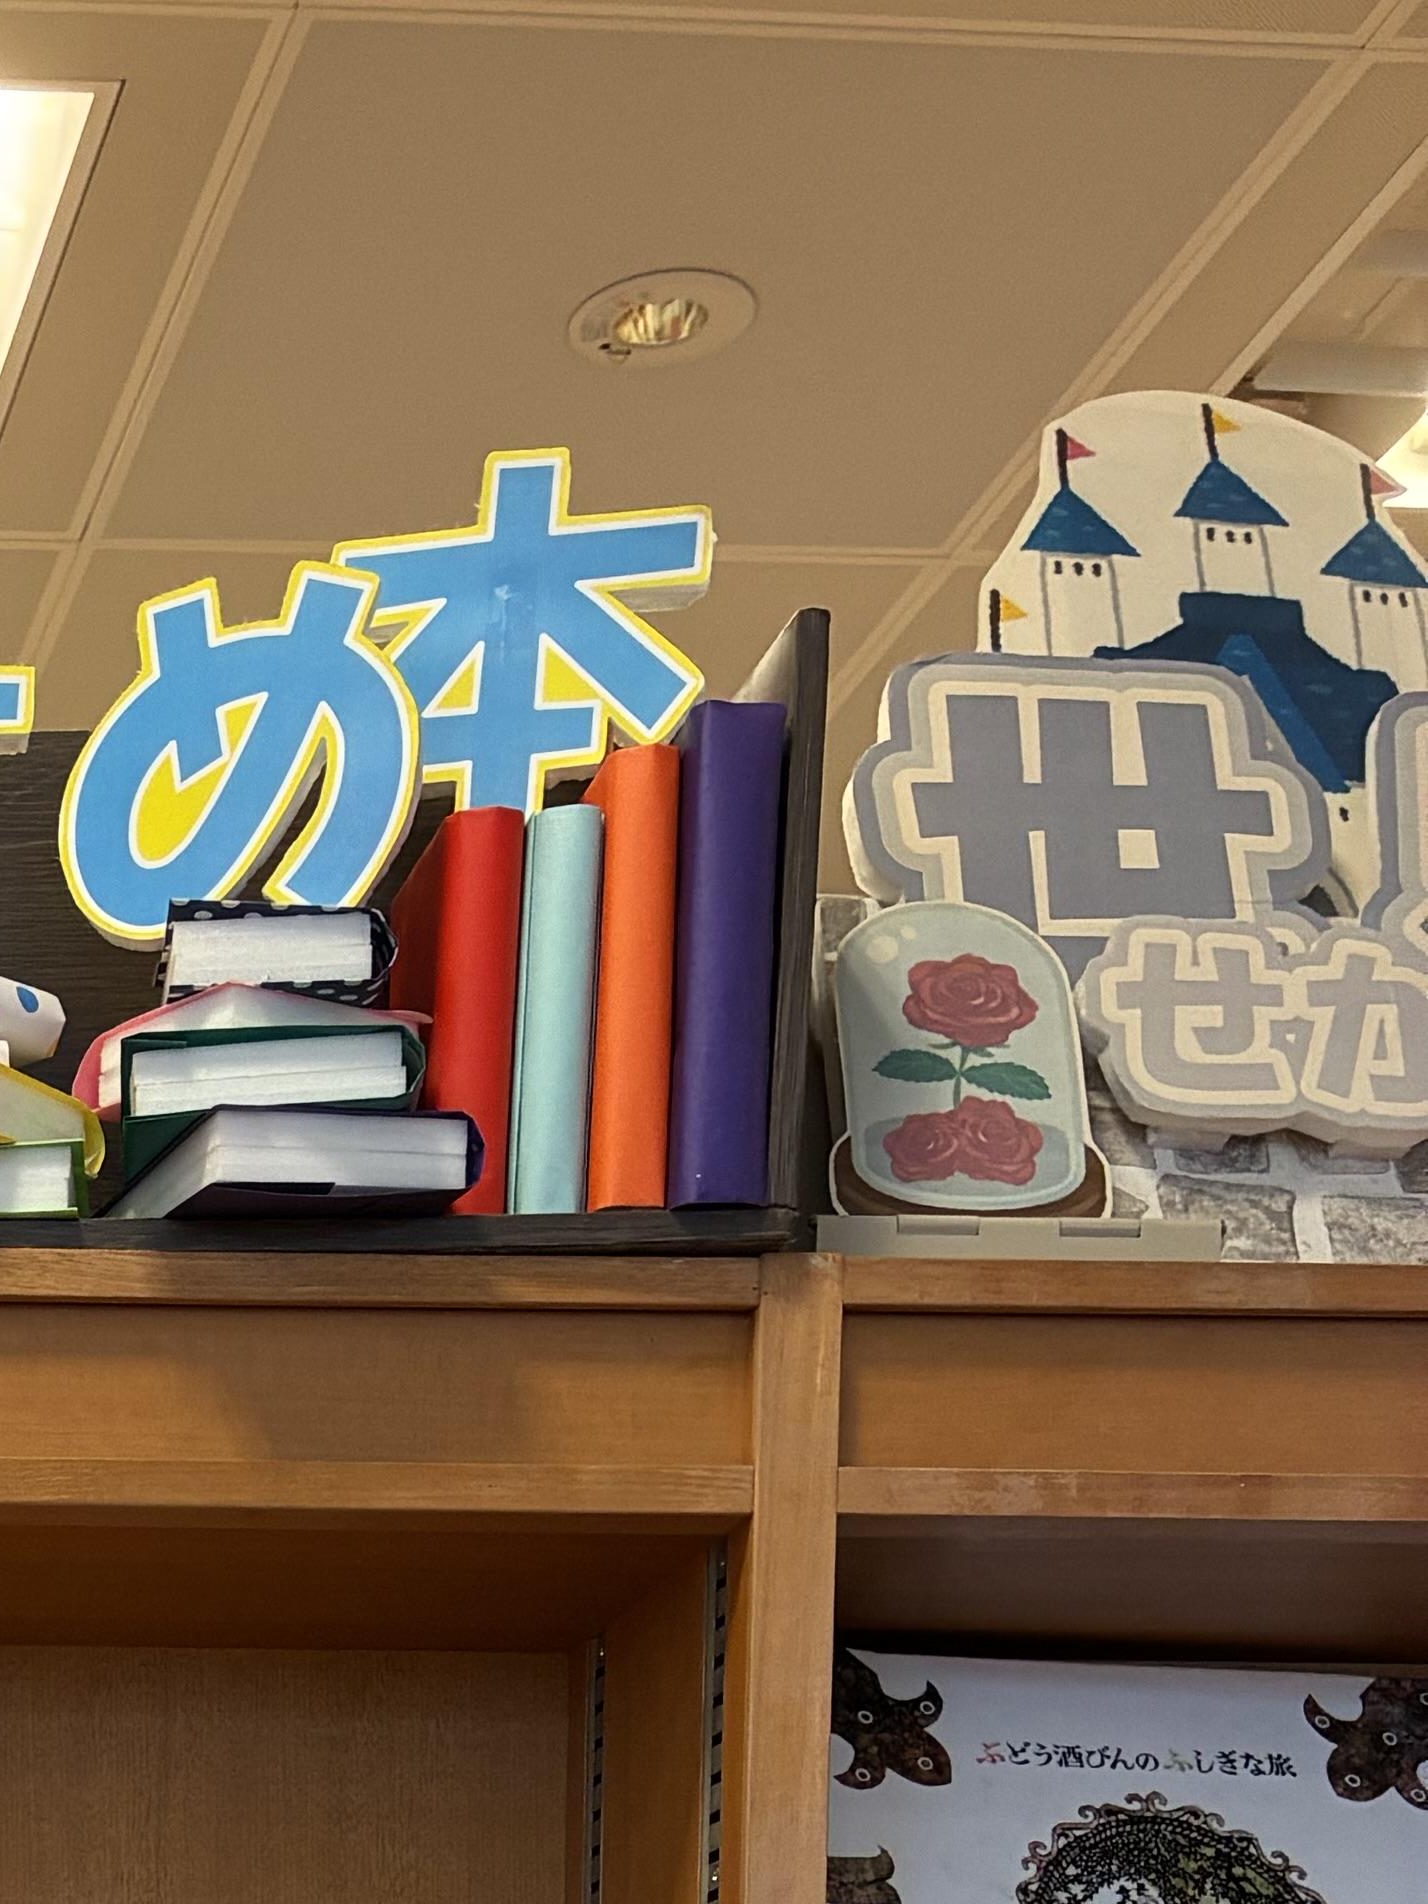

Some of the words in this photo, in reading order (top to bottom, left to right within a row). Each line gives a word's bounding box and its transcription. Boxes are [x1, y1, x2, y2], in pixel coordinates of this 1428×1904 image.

[975, 1739, 1299, 1780] ぶどう酒びんのふしぎな旅
